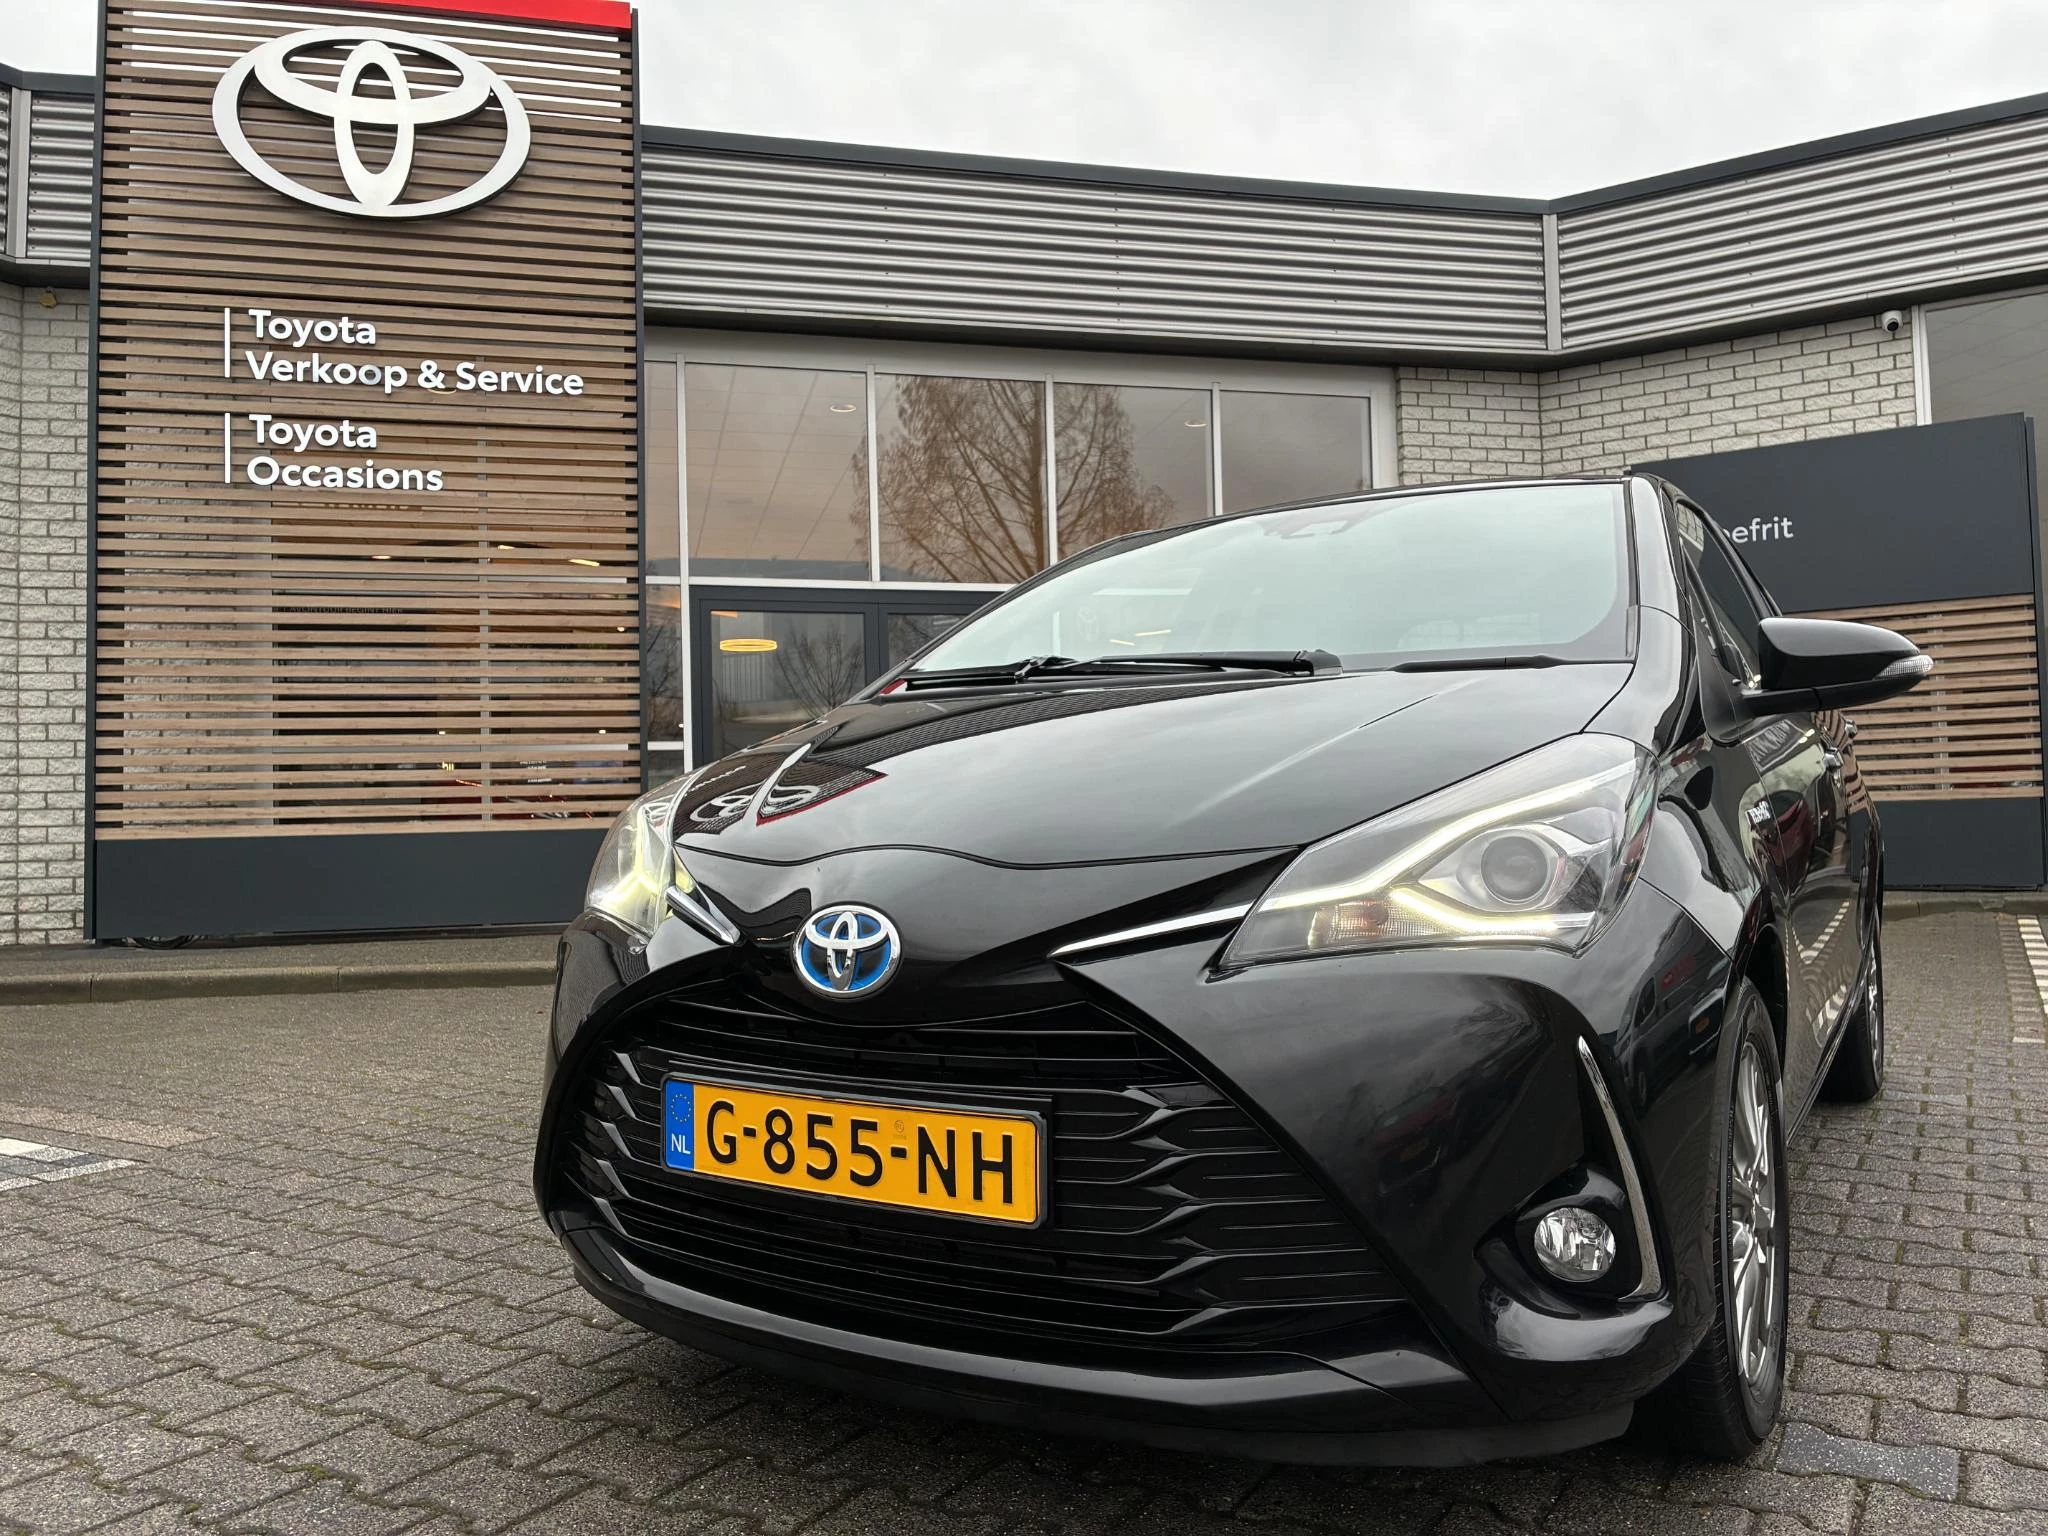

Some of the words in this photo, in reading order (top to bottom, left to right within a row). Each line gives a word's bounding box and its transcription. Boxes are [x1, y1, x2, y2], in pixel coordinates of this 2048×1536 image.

[248, 309, 376, 348] Toyota
[245, 350, 408, 394] Verkoop
[417, 359, 446, 389] &
[455, 361, 584, 395] Service
[248, 414, 377, 452] Toyota
[246, 455, 444, 491] Occasions
[671, 1133, 691, 1155] NL
[706, 1099, 1013, 1205] G-855-NH
